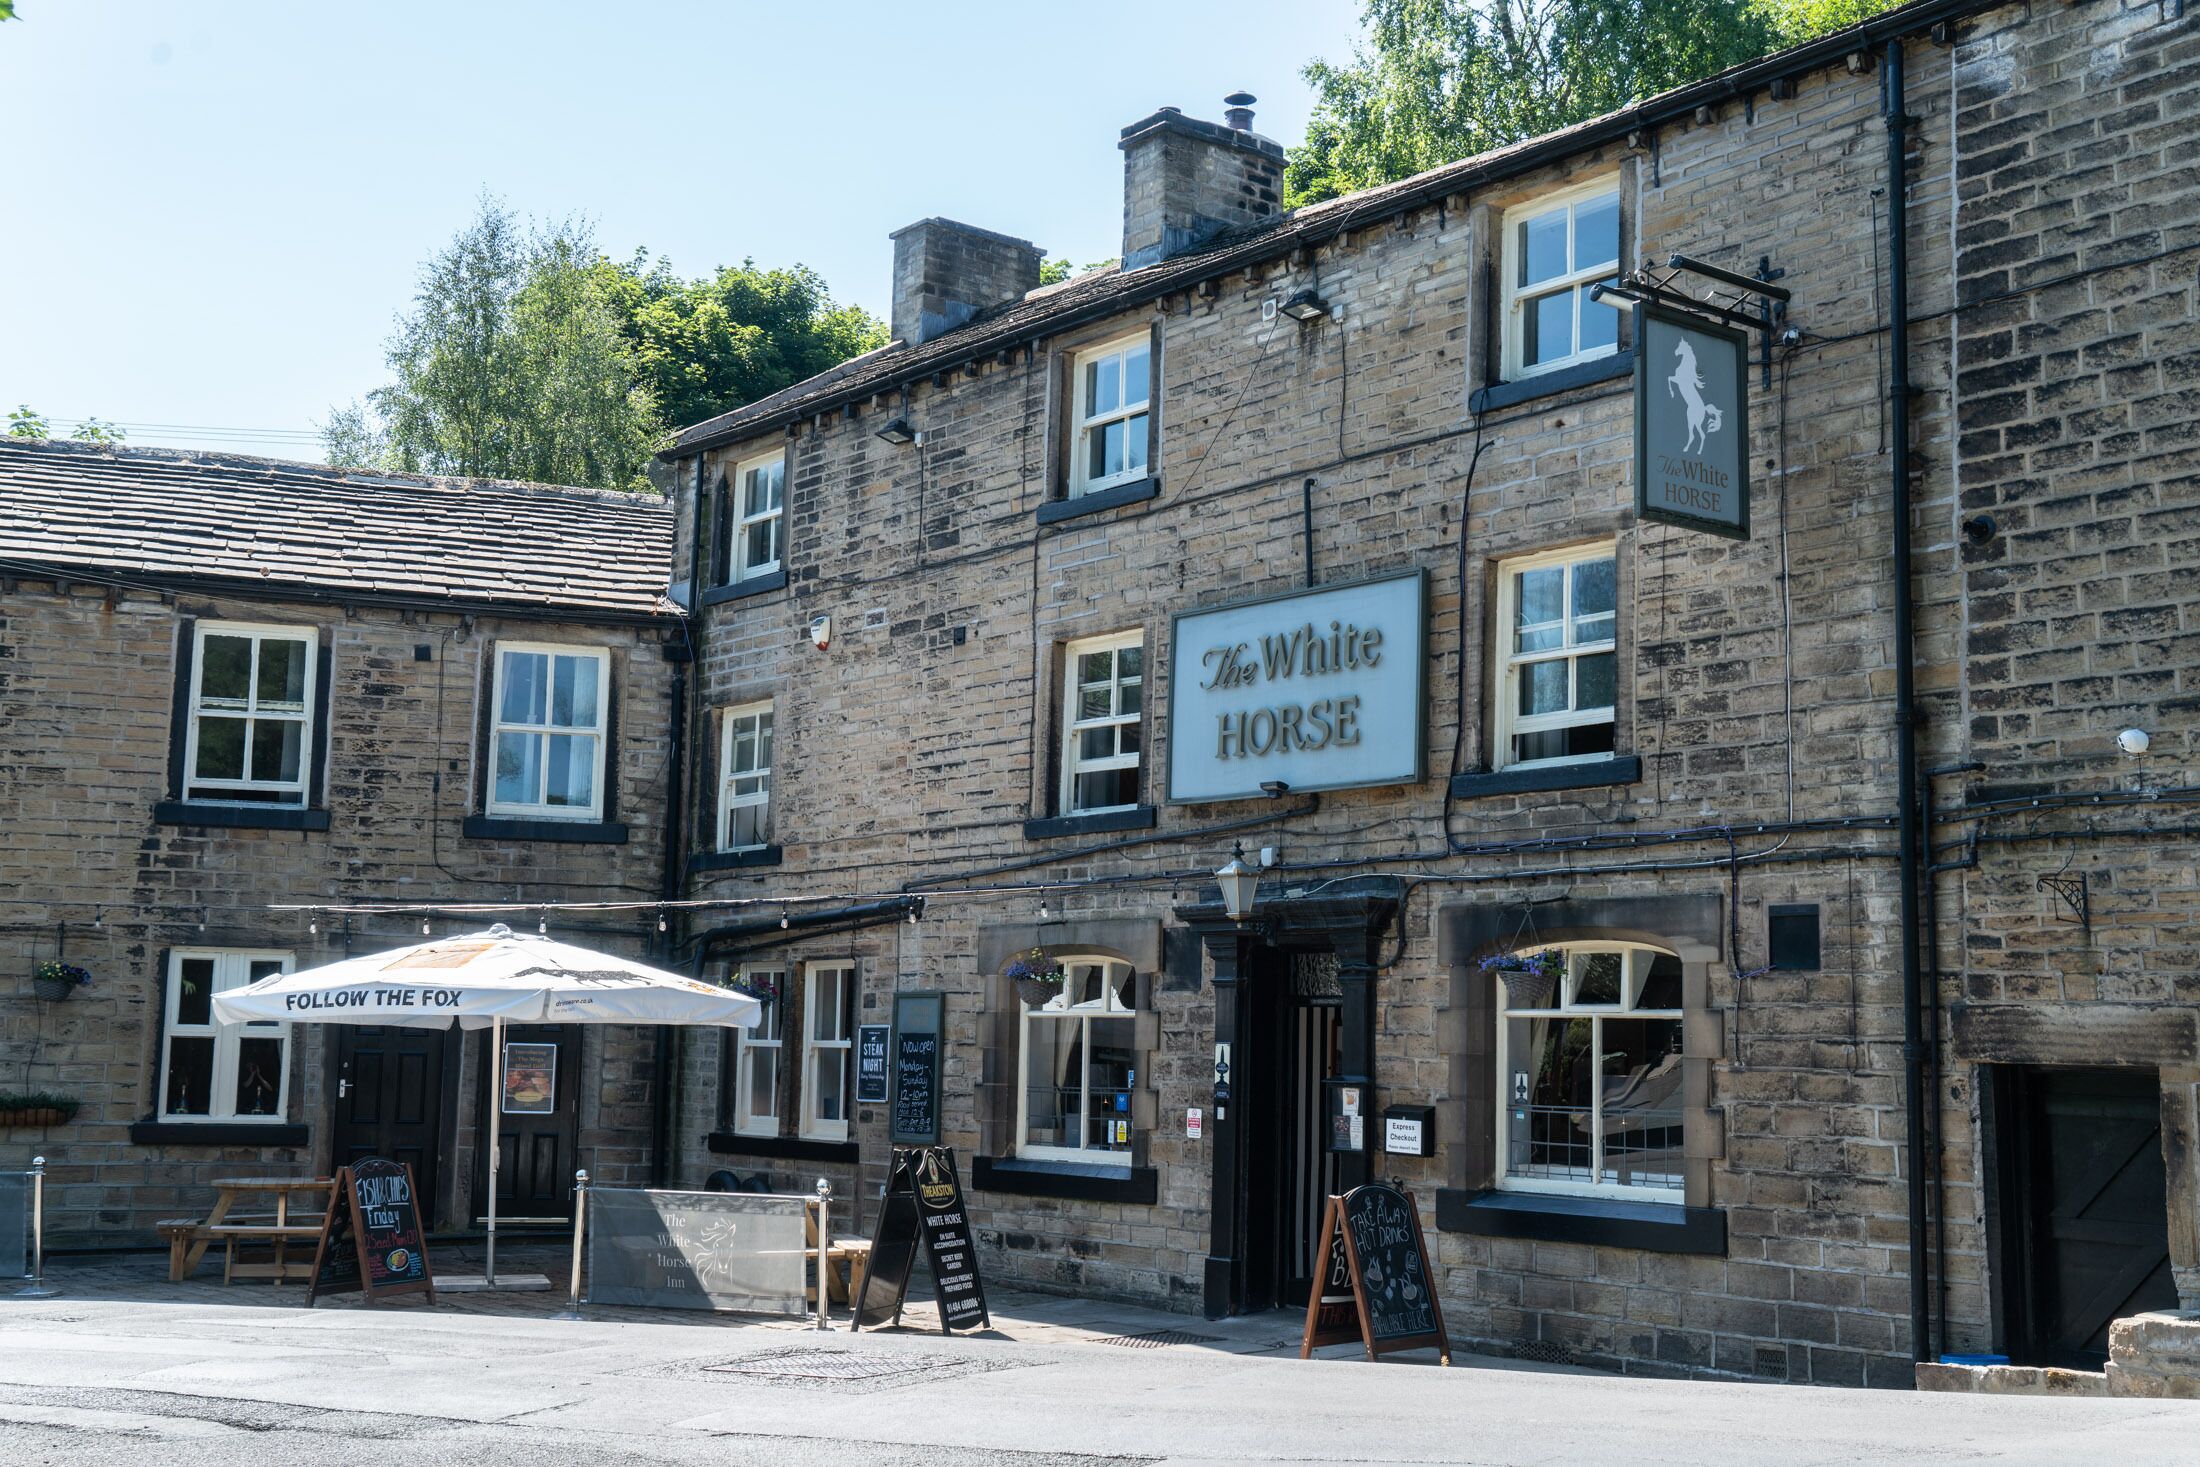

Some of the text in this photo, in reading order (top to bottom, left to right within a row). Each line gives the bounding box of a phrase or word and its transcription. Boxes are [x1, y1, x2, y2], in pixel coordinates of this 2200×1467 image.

[1656, 455, 1728, 488] The White
[1664, 481, 1721, 512] HORSE
[1200, 620, 1383, 690] The White
[1216, 695, 1361, 759] HORSE
[286, 989, 463, 1011] FOLLOW THE FOX
[863, 1043, 884, 1056] STEAK
[863, 1058, 884, 1072] NIGHT
[1392, 1123, 1415, 1131] Express
[1390, 1133, 1417, 1142] Checkout
[367, 1207, 400, 1233] Friday
[664, 1213, 686, 1227] The
[926, 1213, 962, 1227] WHITE HORSE
[1351, 1206, 1376, 1233] TAKE
[1377, 1205, 1409, 1226] AWAY
[657, 1234, 691, 1248] White
[933, 1239, 966, 1250] ACCOMMODATION
[1355, 1225, 1410, 1255] HOT DRINKS
[657, 1253, 692, 1268] Horse
[946, 1261, 962, 1270] GARDEN
[667, 1275, 685, 1288] Inn
[940, 1276, 958, 1286] DELICIOUS
[962, 1282, 973, 1290] FOOD
[946, 1301, 961, 1313] 01484
[1406, 1309, 1429, 1330] HERE
